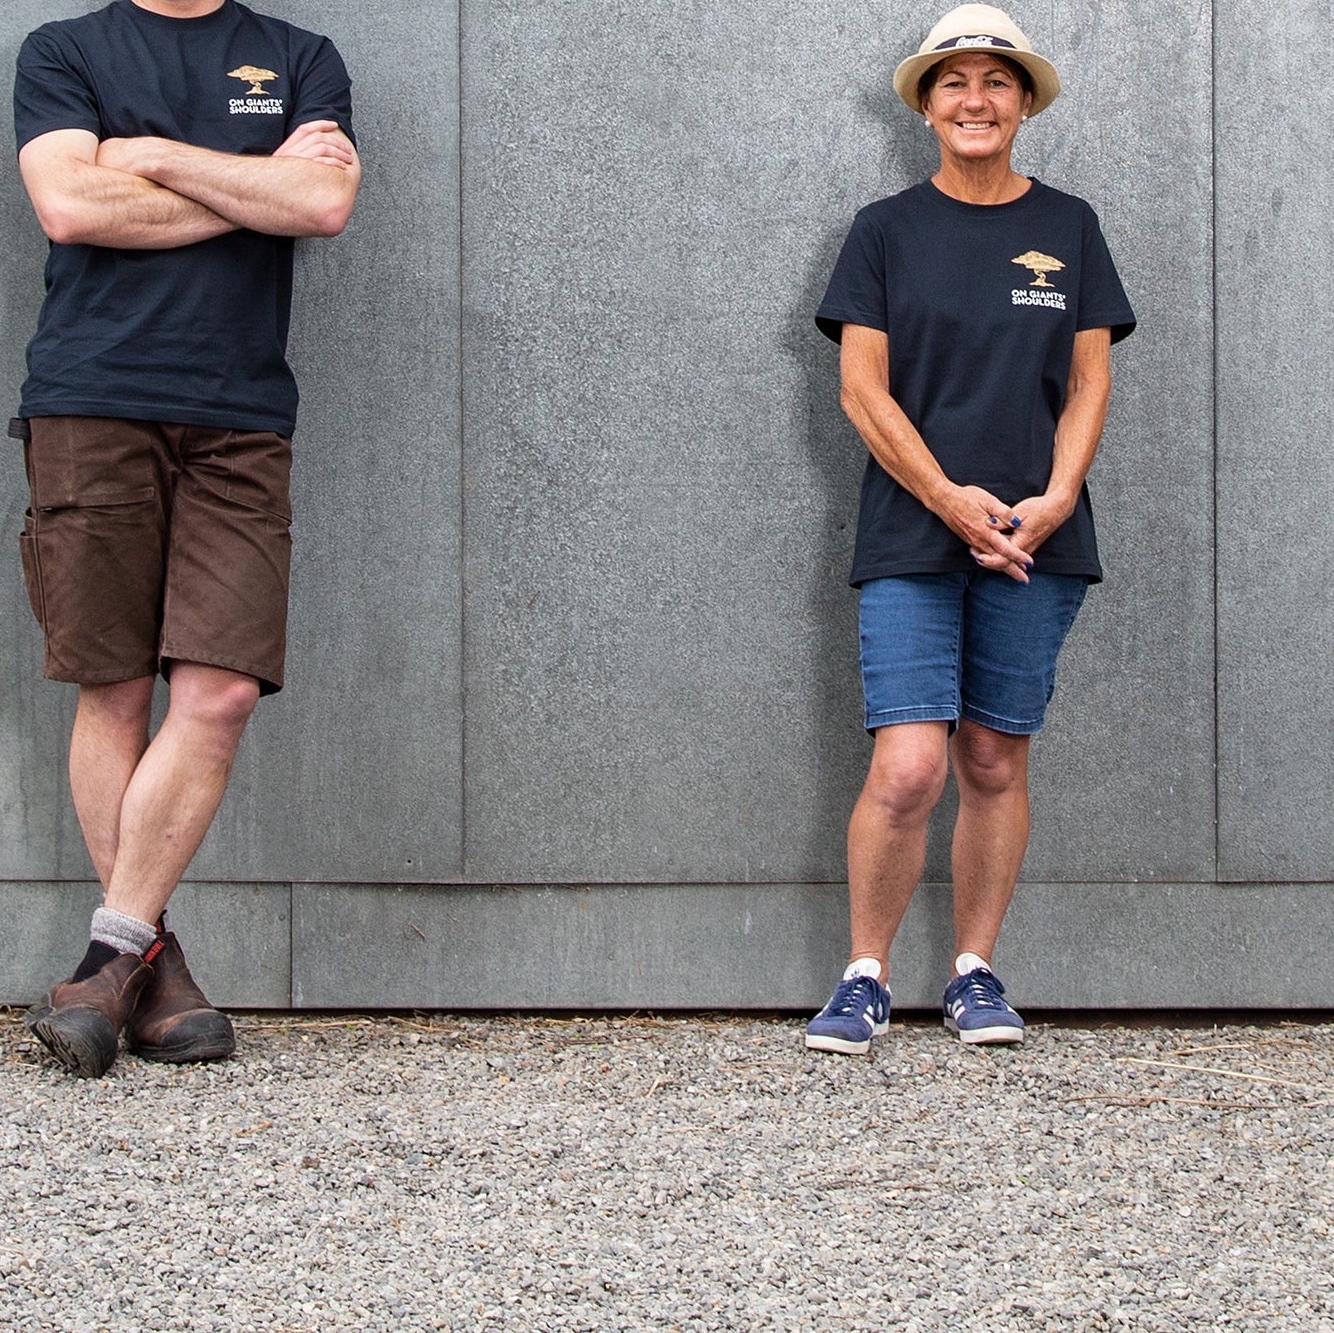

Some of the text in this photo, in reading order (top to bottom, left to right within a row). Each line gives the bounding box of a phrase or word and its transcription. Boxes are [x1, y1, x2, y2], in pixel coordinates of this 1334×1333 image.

[228, 98, 245, 106] ON
[229, 106, 284, 114] SHOULDERS
[1011, 289, 1027, 297] ON
[1011, 296, 1066, 311] SHOULDERS
